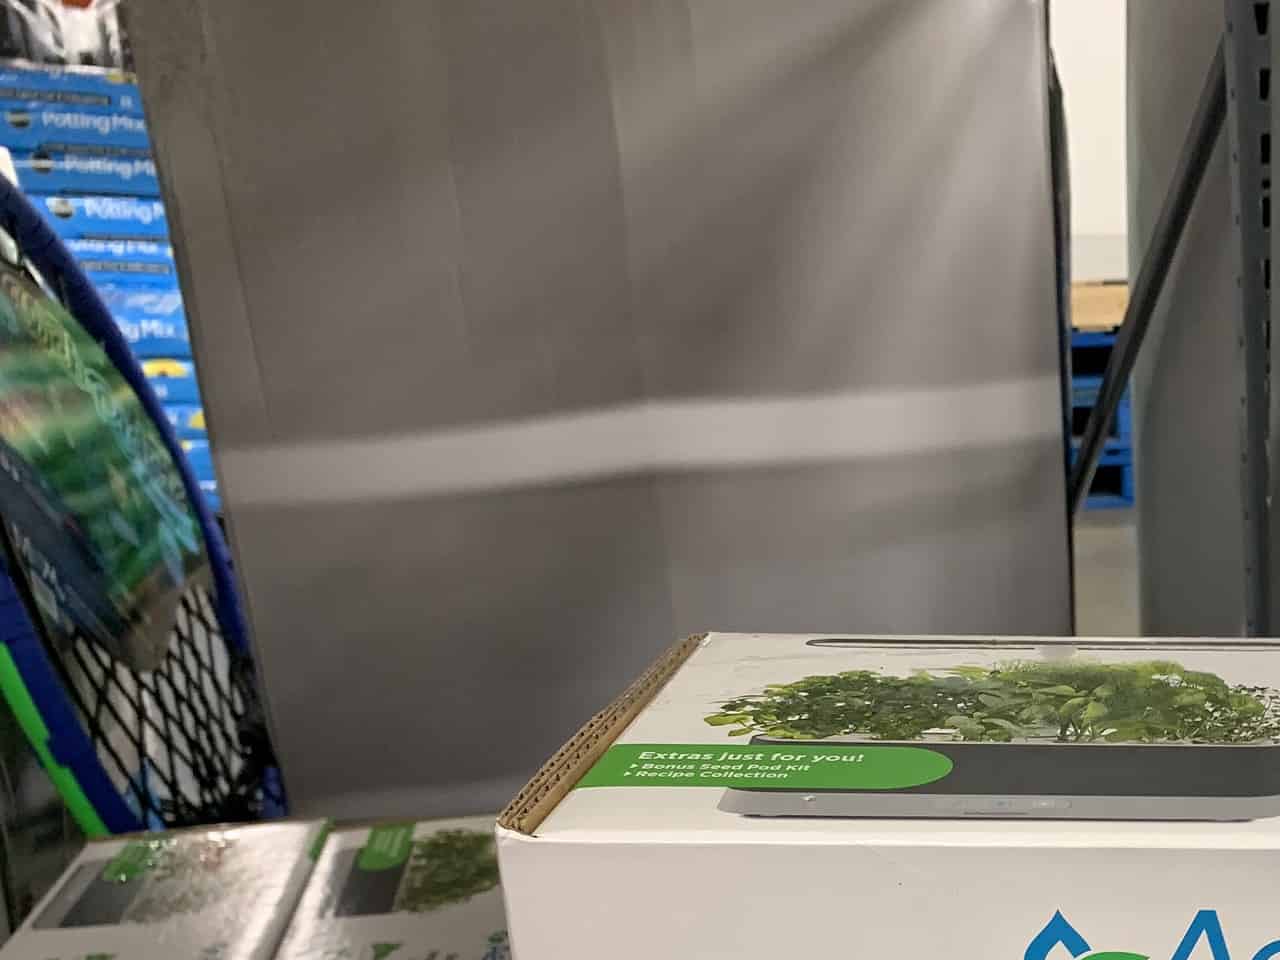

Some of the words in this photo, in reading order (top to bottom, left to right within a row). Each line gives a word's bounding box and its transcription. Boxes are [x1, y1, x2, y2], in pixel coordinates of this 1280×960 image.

[42, 112, 110, 135] Potting
[64, 155, 132, 180] Potting
[140, 319, 176, 338] Mix
[638, 751, 713, 761] Extras
[716, 752, 762, 762] just
[770, 752, 806, 762] for
[811, 754, 865, 763] you!
[641, 763, 695, 771] Bonus
[699, 763, 744, 771] Seed
[746, 763, 783, 771] Pod
[635, 771, 694, 779] Recipe
[699, 771, 789, 779] Collection
